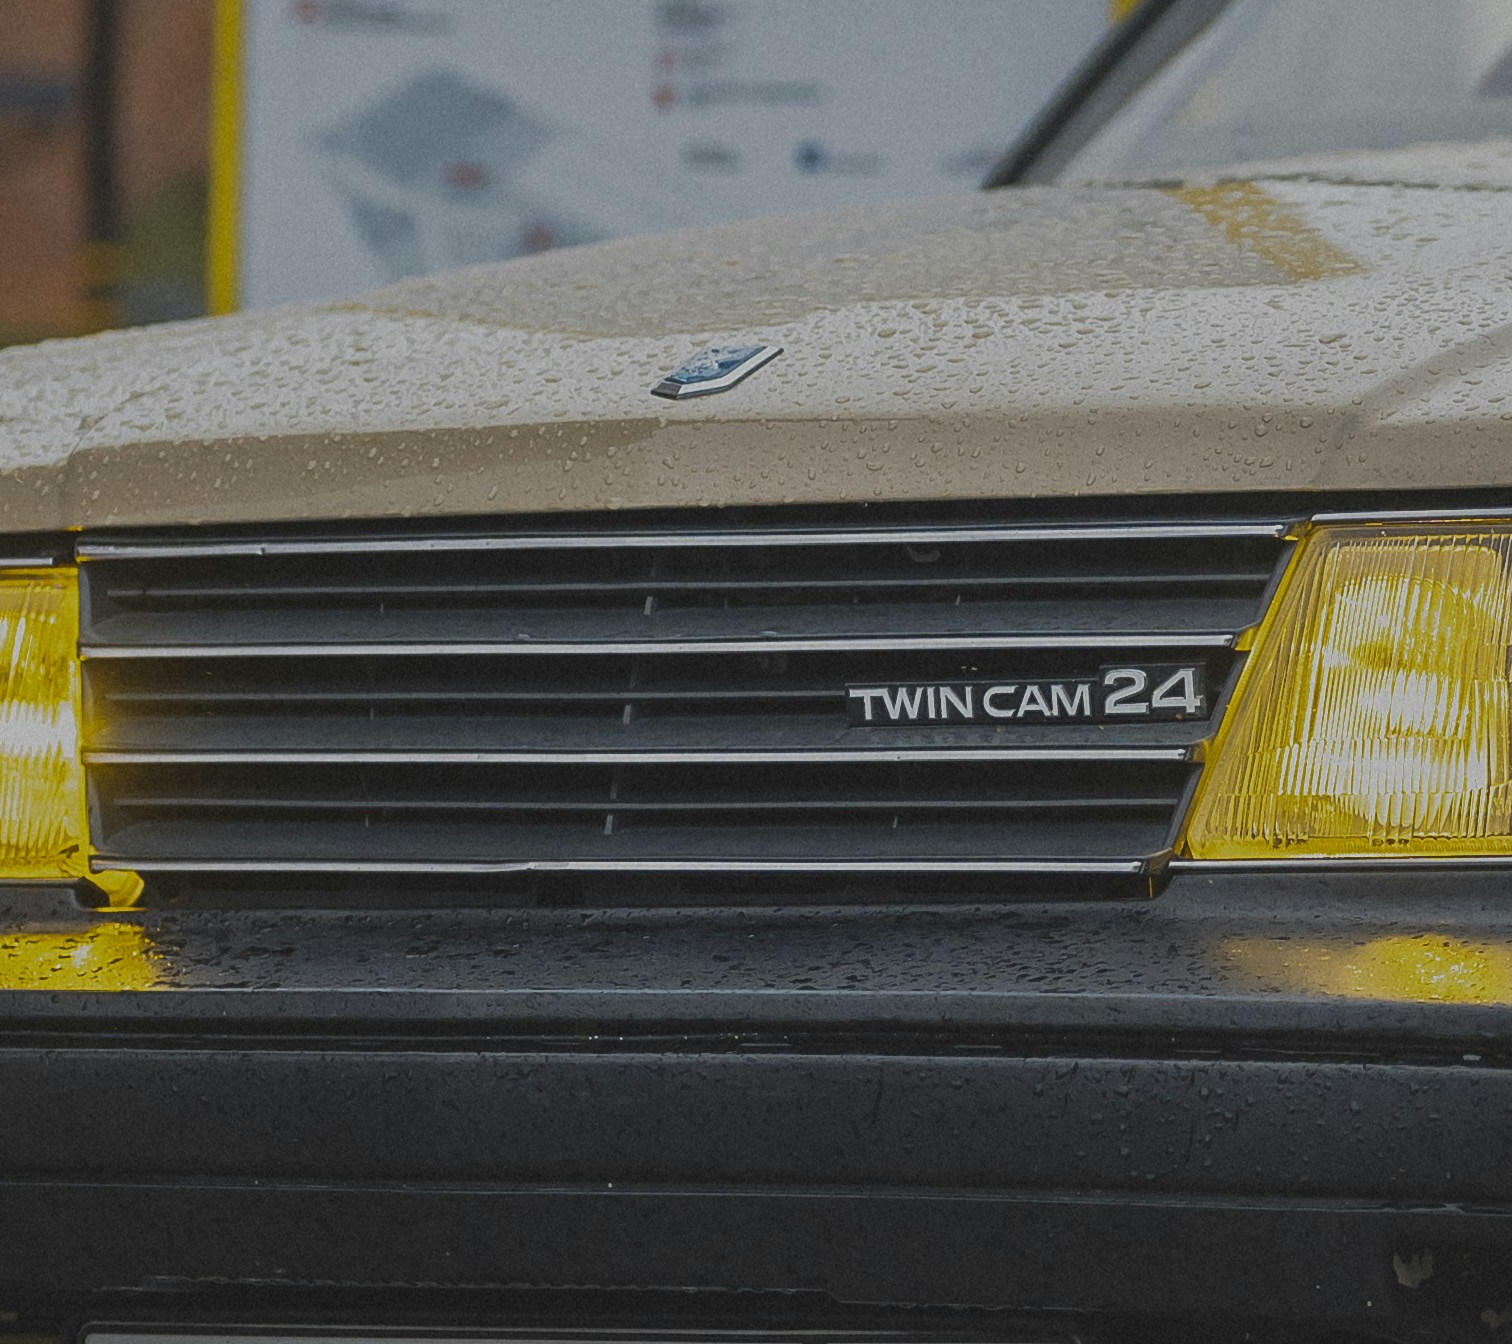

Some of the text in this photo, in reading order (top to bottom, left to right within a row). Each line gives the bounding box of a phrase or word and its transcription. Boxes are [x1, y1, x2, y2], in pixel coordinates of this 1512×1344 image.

[849, 668, 1205, 720] TWIN CAM 24
